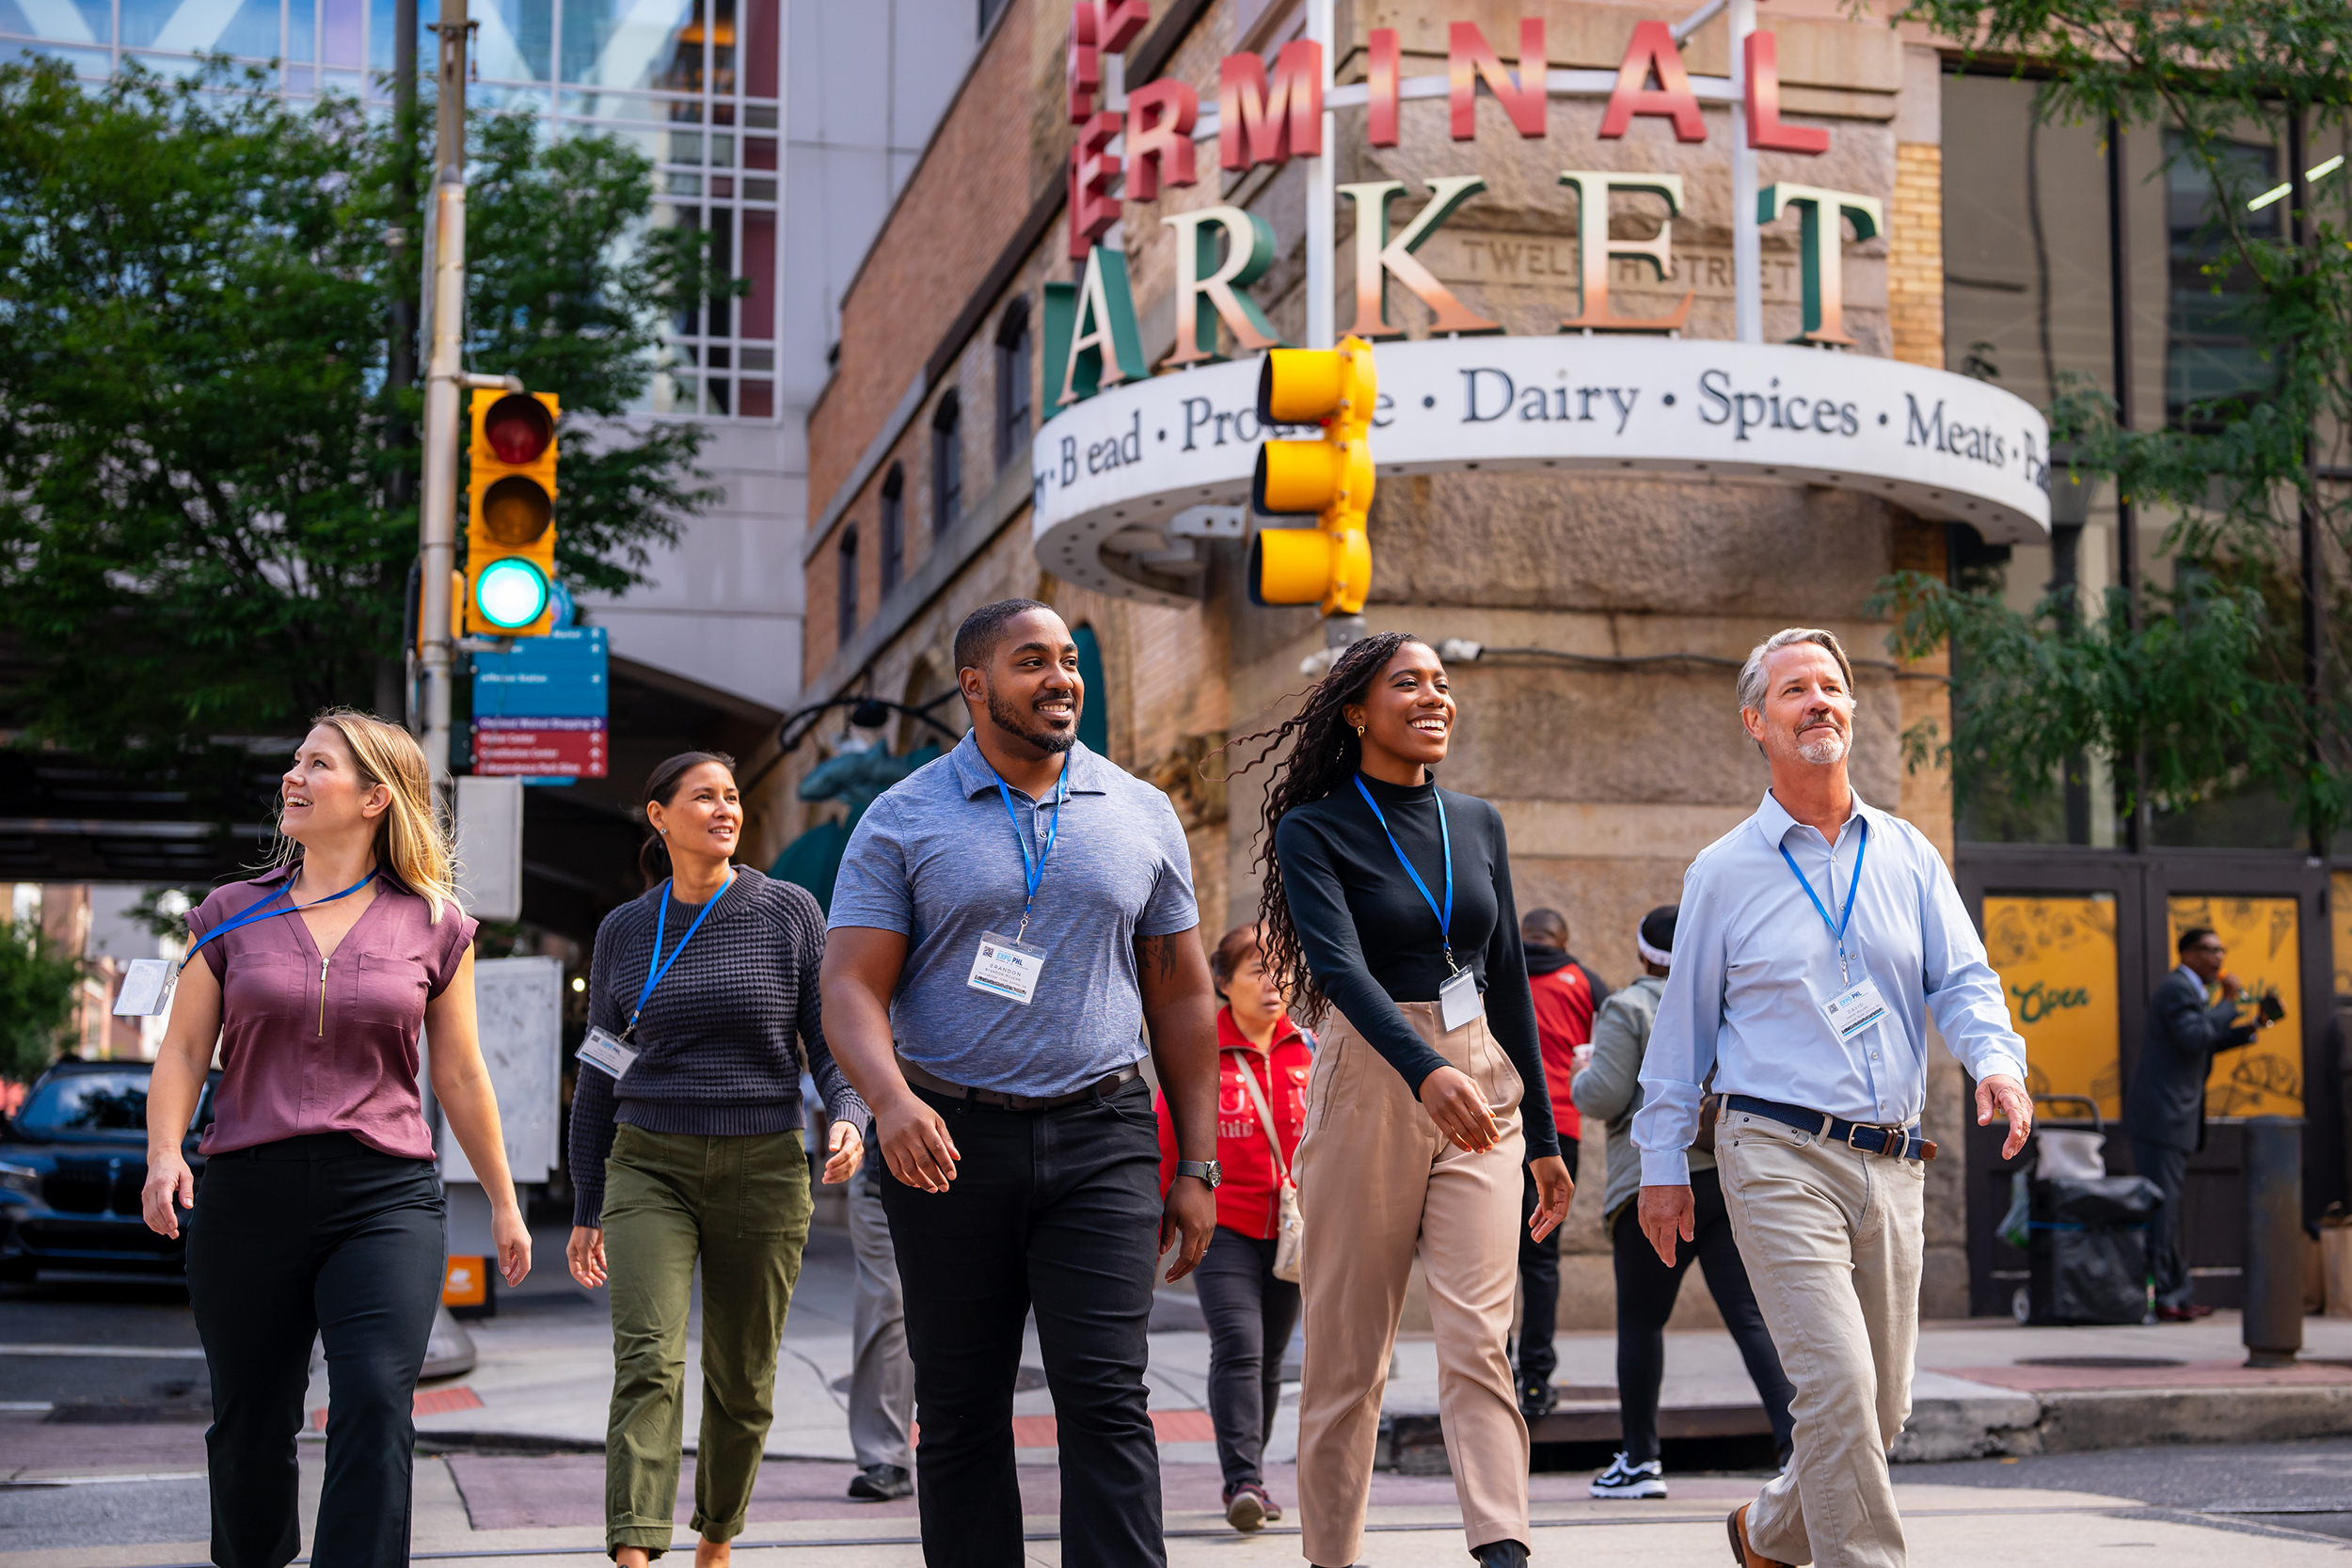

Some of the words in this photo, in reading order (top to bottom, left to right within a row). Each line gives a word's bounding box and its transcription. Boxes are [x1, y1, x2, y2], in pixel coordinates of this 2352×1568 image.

[1460, 369, 1640, 436] Dairy
[1697, 370, 1860, 442] Spices
[1904, 391, 2006, 468] Meats
[996, 952, 1012, 962] EXPO
[1011, 957, 1024, 966] PHL
[989, 963, 1022, 977] BRANDON
[1851, 990, 1862, 1000] PHL
[2010, 980, 2091, 1023] Open
[1847, 1002, 1864, 1014] DAVID
